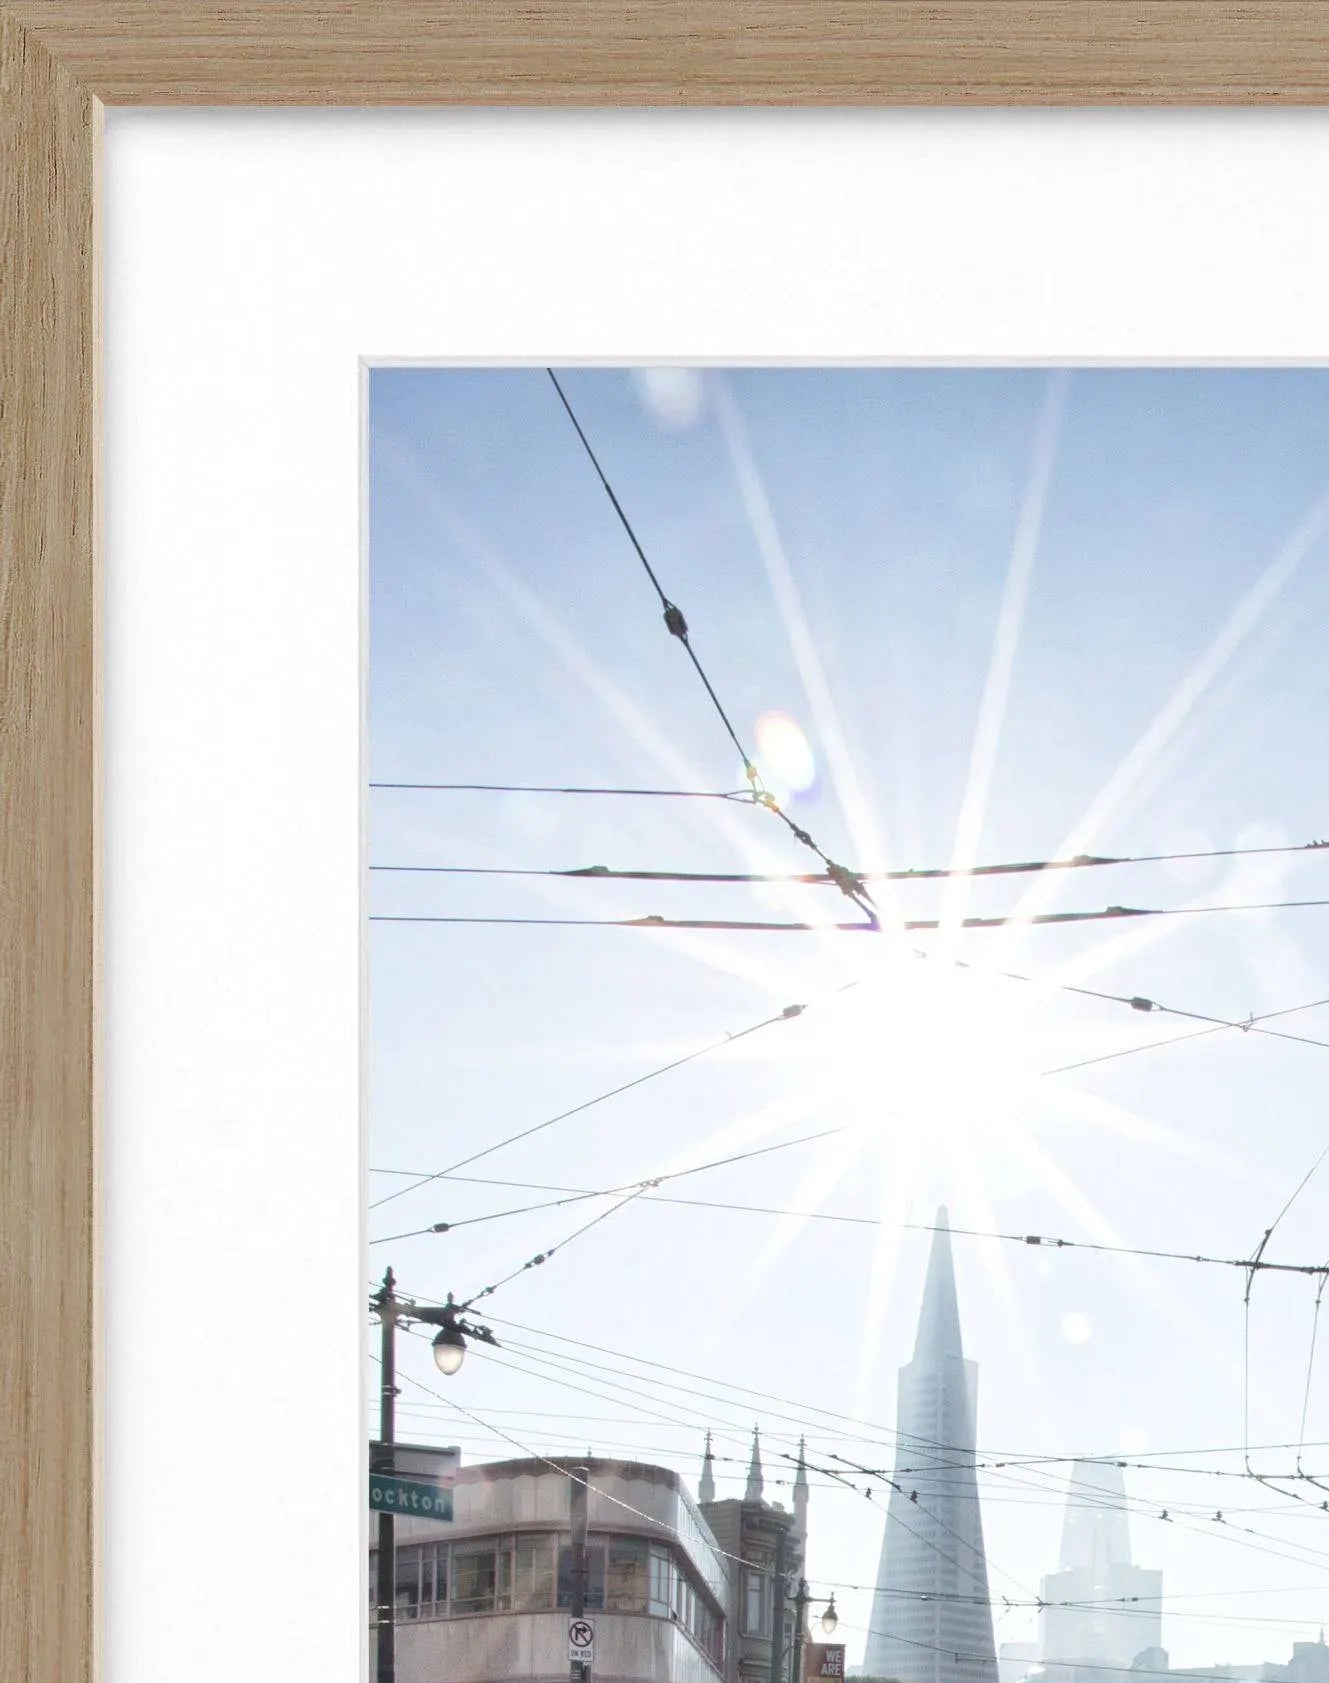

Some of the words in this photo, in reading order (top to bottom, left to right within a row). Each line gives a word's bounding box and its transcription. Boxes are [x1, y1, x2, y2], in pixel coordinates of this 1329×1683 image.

[372, 1487, 445, 1513] ockton
[825, 1649, 843, 1663] WE
[821, 1662, 841, 1676] ARE
